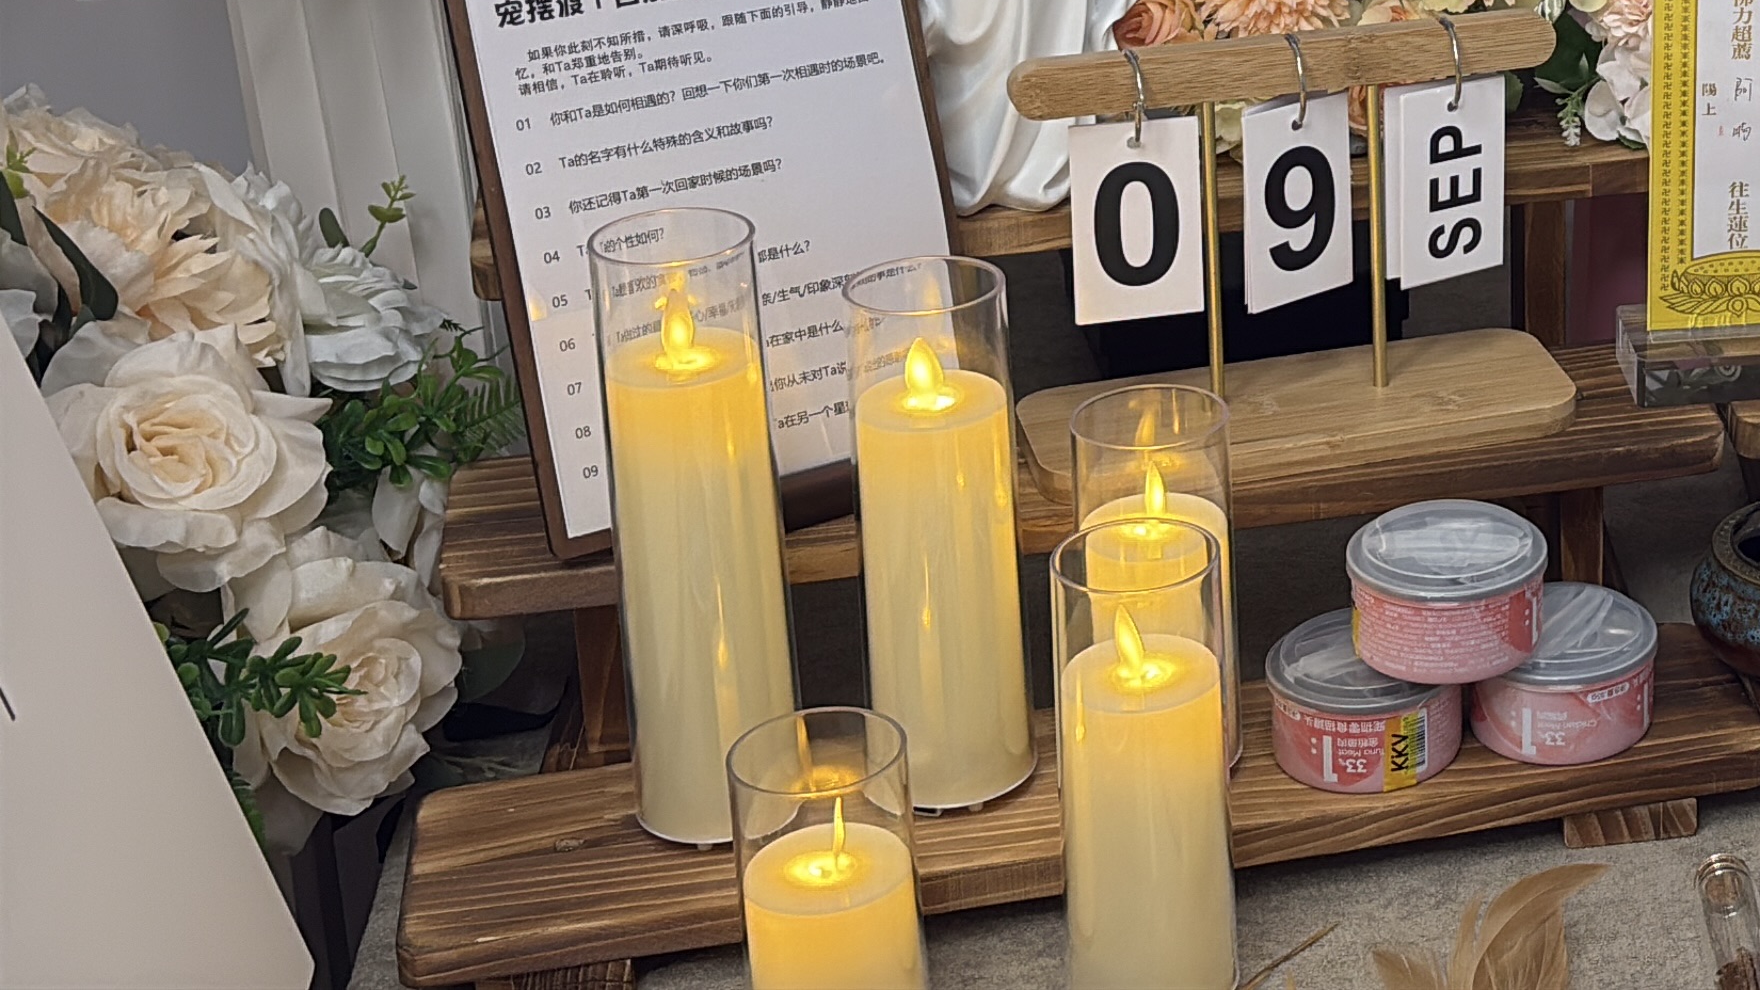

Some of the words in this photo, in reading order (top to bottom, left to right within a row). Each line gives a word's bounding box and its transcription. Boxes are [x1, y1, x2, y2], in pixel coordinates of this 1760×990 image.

[516, 117, 532, 132] 01
[525, 162, 543, 176] 02
[1428, 124, 1483, 260] SEP
[534, 206, 552, 220] 03
[544, 250, 561, 264] 04
[552, 294, 569, 308] 05
[559, 338, 576, 352] 06
[567, 381, 582, 396] 07
[575, 425, 592, 439] 08
[582, 465, 599, 479] 09
